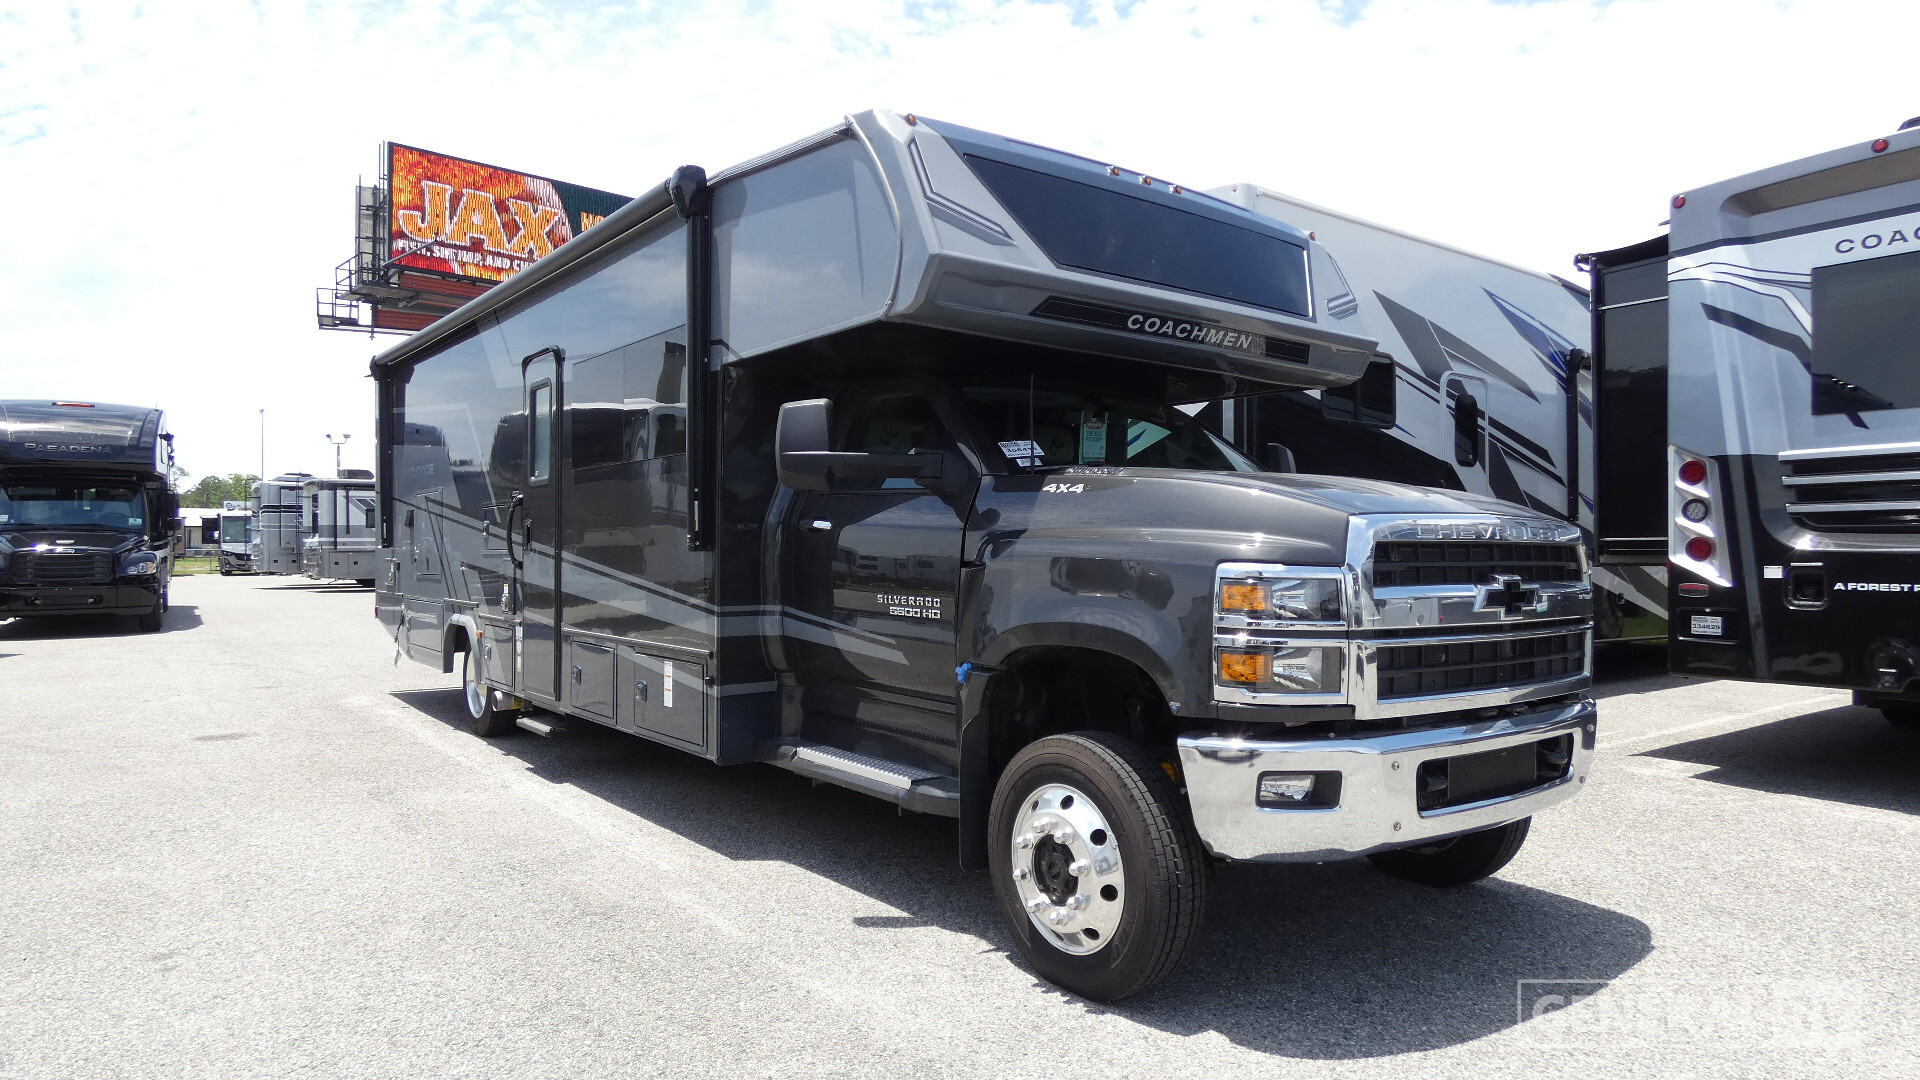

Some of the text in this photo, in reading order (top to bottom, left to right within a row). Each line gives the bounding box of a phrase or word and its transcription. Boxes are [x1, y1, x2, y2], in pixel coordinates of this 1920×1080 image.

[399, 180, 559, 260] JAX
[485, 255, 511, 269] AND
[1127, 314, 1253, 349] COACHMEN
[24, 442, 112, 454] PASADENA
[1833, 582, 1846, 590] A
[1847, 582, 1911, 592] FOREST
[877, 594, 941, 607] SILVERADO
[889, 606, 941, 619] 5500 HD
